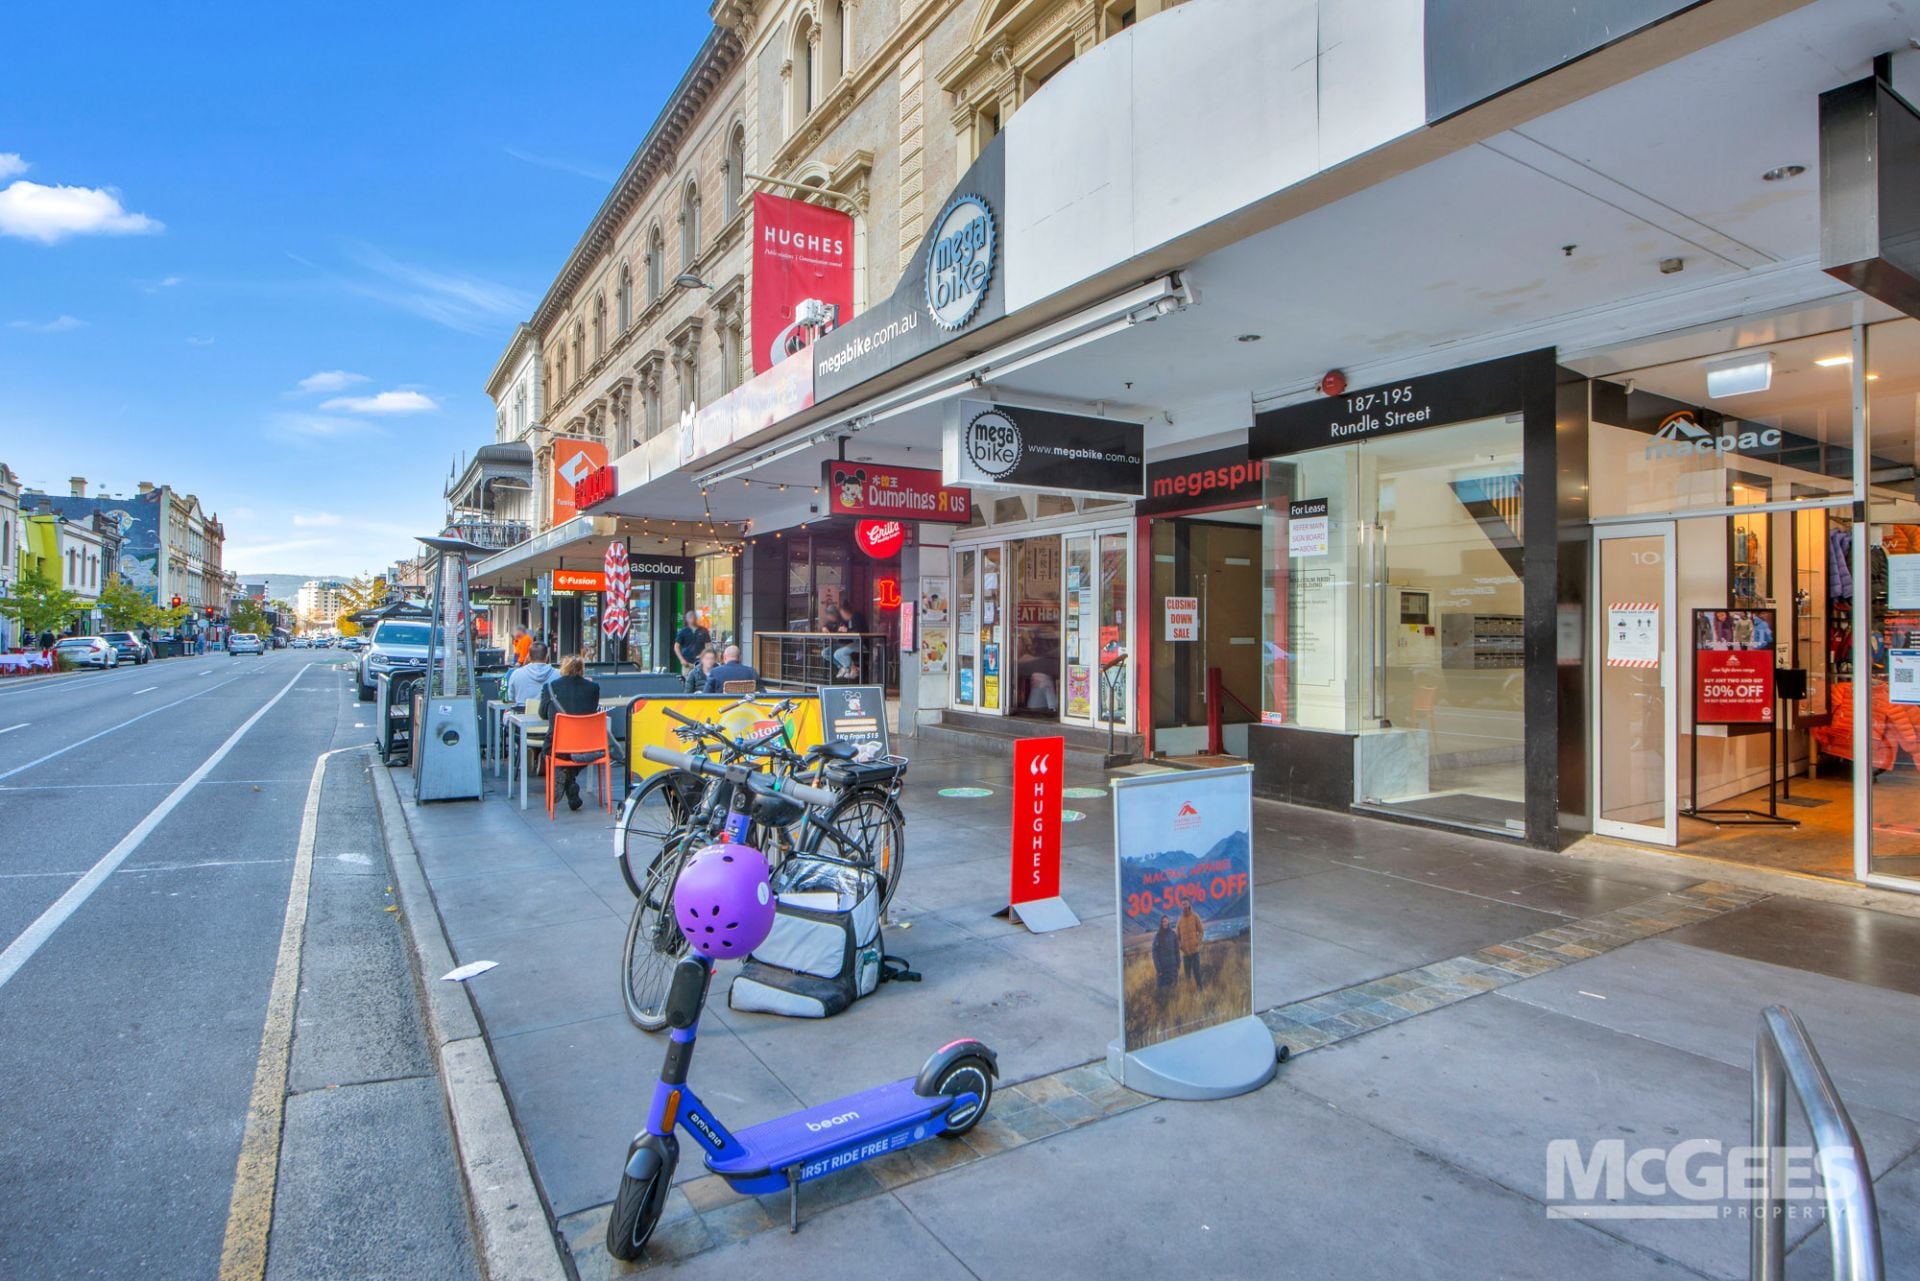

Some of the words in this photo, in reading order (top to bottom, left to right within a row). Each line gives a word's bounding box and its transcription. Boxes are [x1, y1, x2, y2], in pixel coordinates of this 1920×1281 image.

[764, 225, 843, 255] HUGHES
[935, 215, 987, 273] mega
[935, 260, 987, 310] bike
[818, 311, 918, 376] megabike.com.au
[1346, 386, 1413, 414] 187-195
[1330, 418, 1379, 437] Rundle
[1385, 406, 1431, 428] Street
[975, 423, 1014, 447] mega
[1645, 429, 1782, 461] macpac
[974, 442, 1014, 463] bike
[1028, 443, 1141, 465] www.megabike.com.au
[868, 485, 936, 511] Dumplings
[1291, 505, 1303, 515] For
[1304, 504, 1326, 514] Lease
[567, 576, 597, 585] Fusion
[1166, 599, 1197, 610] CLOSING
[1170, 613, 1193, 624] DOWN
[1173, 628, 1190, 638] SALE
[1703, 685, 1734, 697] 50%
[1736, 685, 1764, 697] OFF
[1032, 783, 1044, 885] HUGHES
[1143, 866, 1187, 885] MACPAC
[1190, 859, 1232, 876] APPAREL
[1126, 882, 1207, 918] 30-50%
[1210, 873, 1248, 900] OFF
[805, 1111, 860, 1132] beam
[801, 1160, 830, 1179] IRST
[831, 1149, 859, 1169] RIDE
[861, 1138, 889, 1159] FREE
